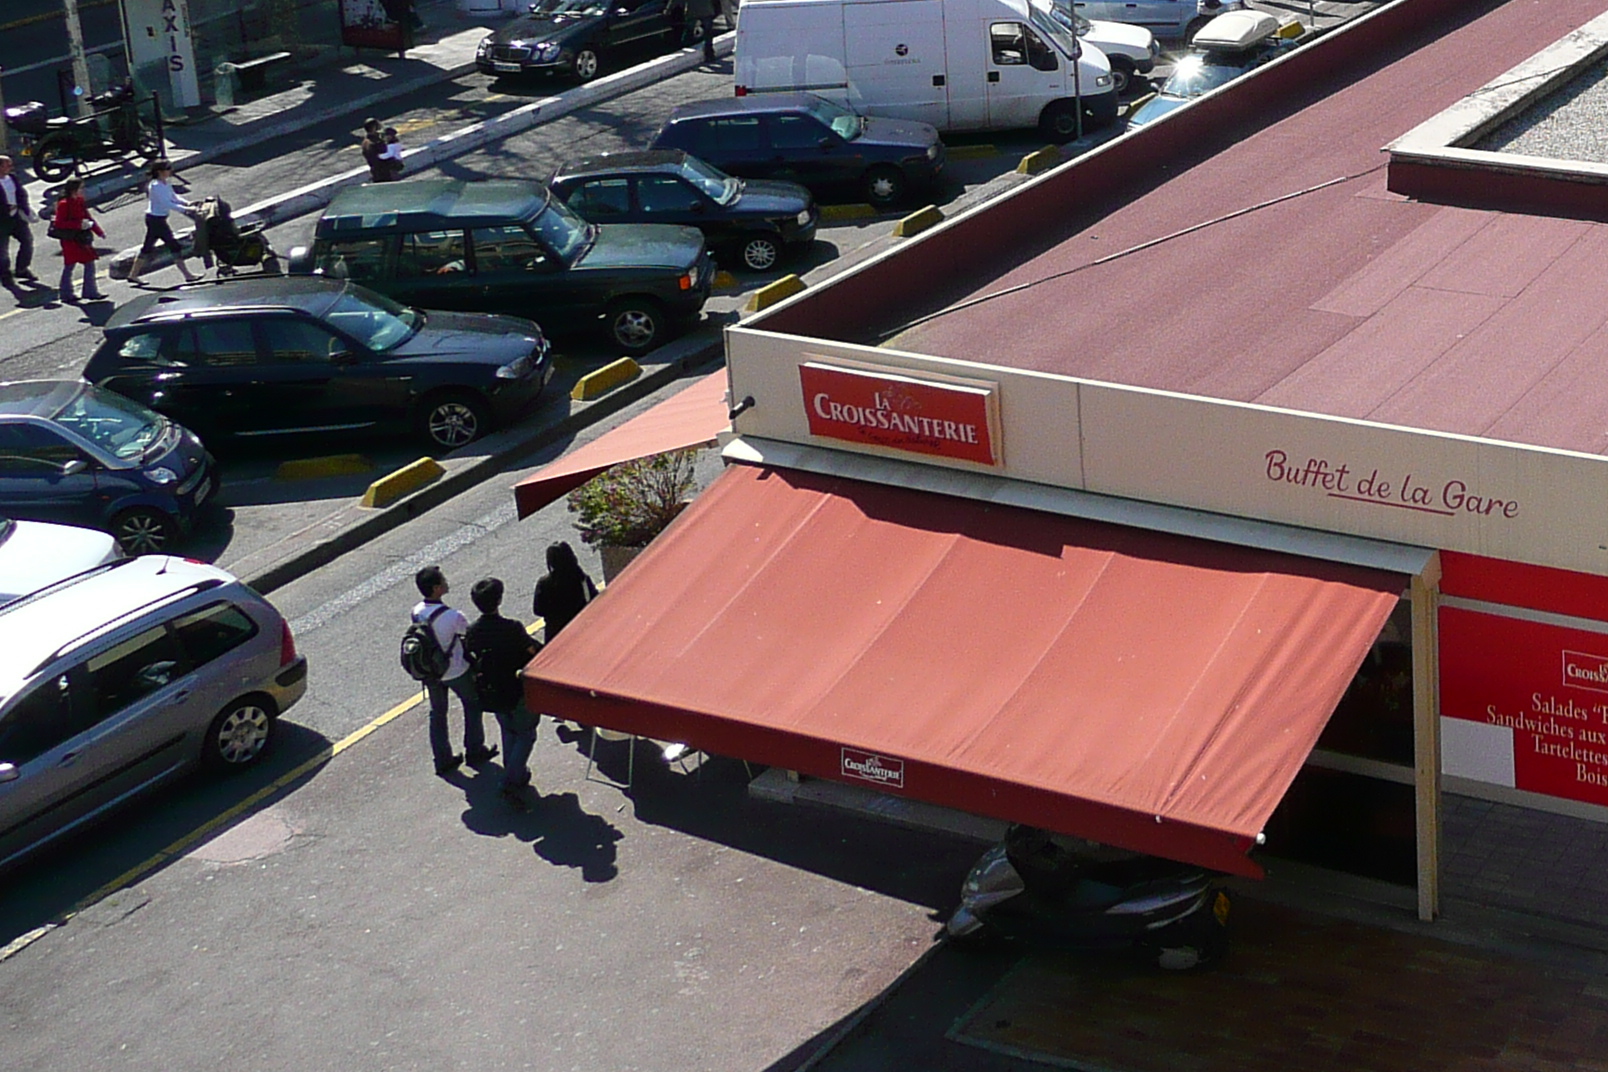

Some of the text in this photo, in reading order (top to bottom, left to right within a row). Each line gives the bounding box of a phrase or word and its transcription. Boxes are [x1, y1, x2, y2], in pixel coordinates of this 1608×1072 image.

[1265, 449, 1518, 519] Buffet de la Gare
[1487, 704, 1574, 739] Sandwiches
[1579, 728, 1607, 746] aux
[1532, 692, 1588, 721] Salades
[1531, 733, 1608, 766] Tartelettes
